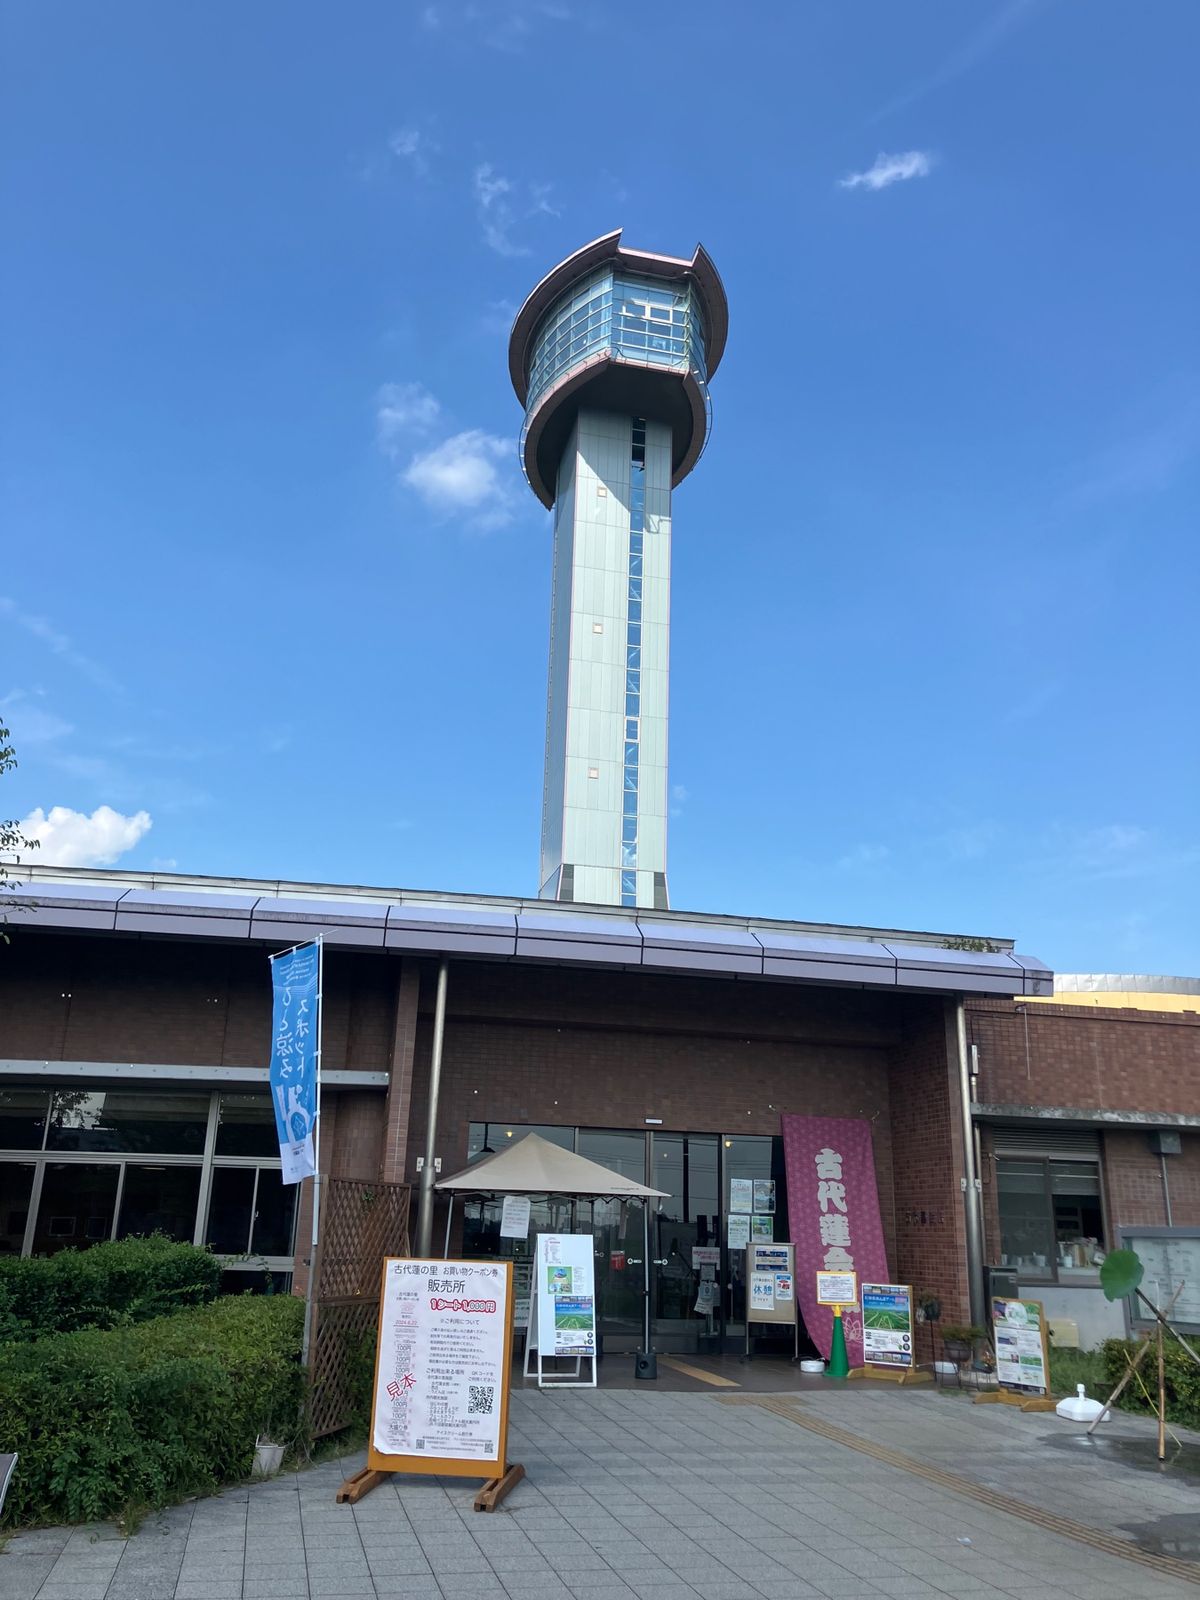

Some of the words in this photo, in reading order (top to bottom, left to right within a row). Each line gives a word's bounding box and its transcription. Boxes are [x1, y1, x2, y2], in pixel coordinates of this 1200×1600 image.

[815, 1148, 860, 1313] 古代蓮会
[394, 1265, 438, 1276] 古代蓮の里
[443, 1266, 498, 1277] お買い物クーポン券
[427, 1279, 465, 1293] 販売所
[387, 1373, 416, 1401] 見本
